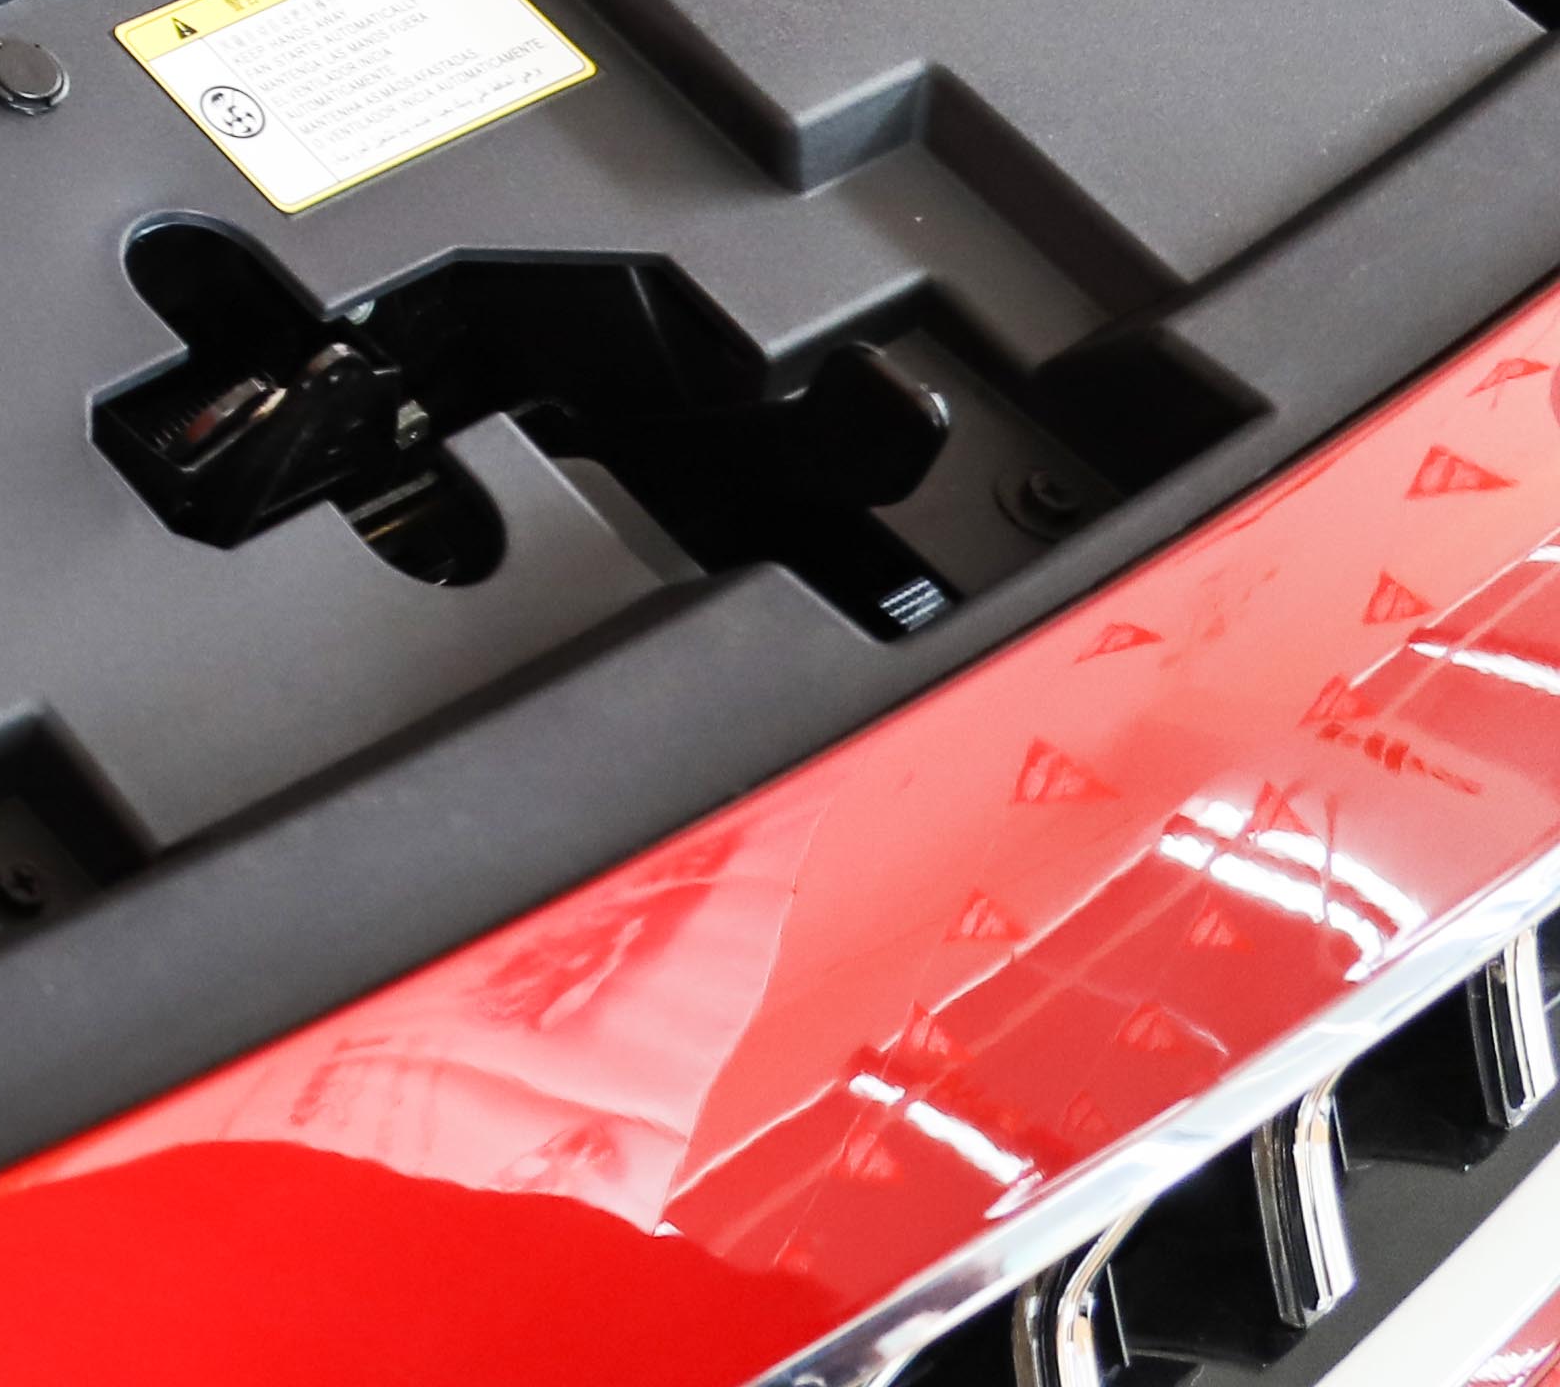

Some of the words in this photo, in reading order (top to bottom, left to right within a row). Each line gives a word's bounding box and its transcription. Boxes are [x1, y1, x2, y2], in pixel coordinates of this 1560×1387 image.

[233, 46, 267, 66] KEEP
[269, 26, 312, 50] HANDS
[315, 10, 348, 29] AWAY
[246, 63, 271, 80] FAN
[273, 41, 321, 67] STARTS
[259, 60, 322, 94] MANTENGA
[323, 49, 346, 65] LAS
[347, 30, 389, 54] MANOS
[389, 12, 429, 35] FUERA
[289, 63, 358, 100] VENTILADOR
[326, 106, 398, 144] VENTILADOR
[399, 89, 435, 110] INICIA
[436, 38, 544, 94] AUTOMATICAMENTE
[299, 101, 363, 136] MANTENHA
[363, 92, 382, 106] AS
